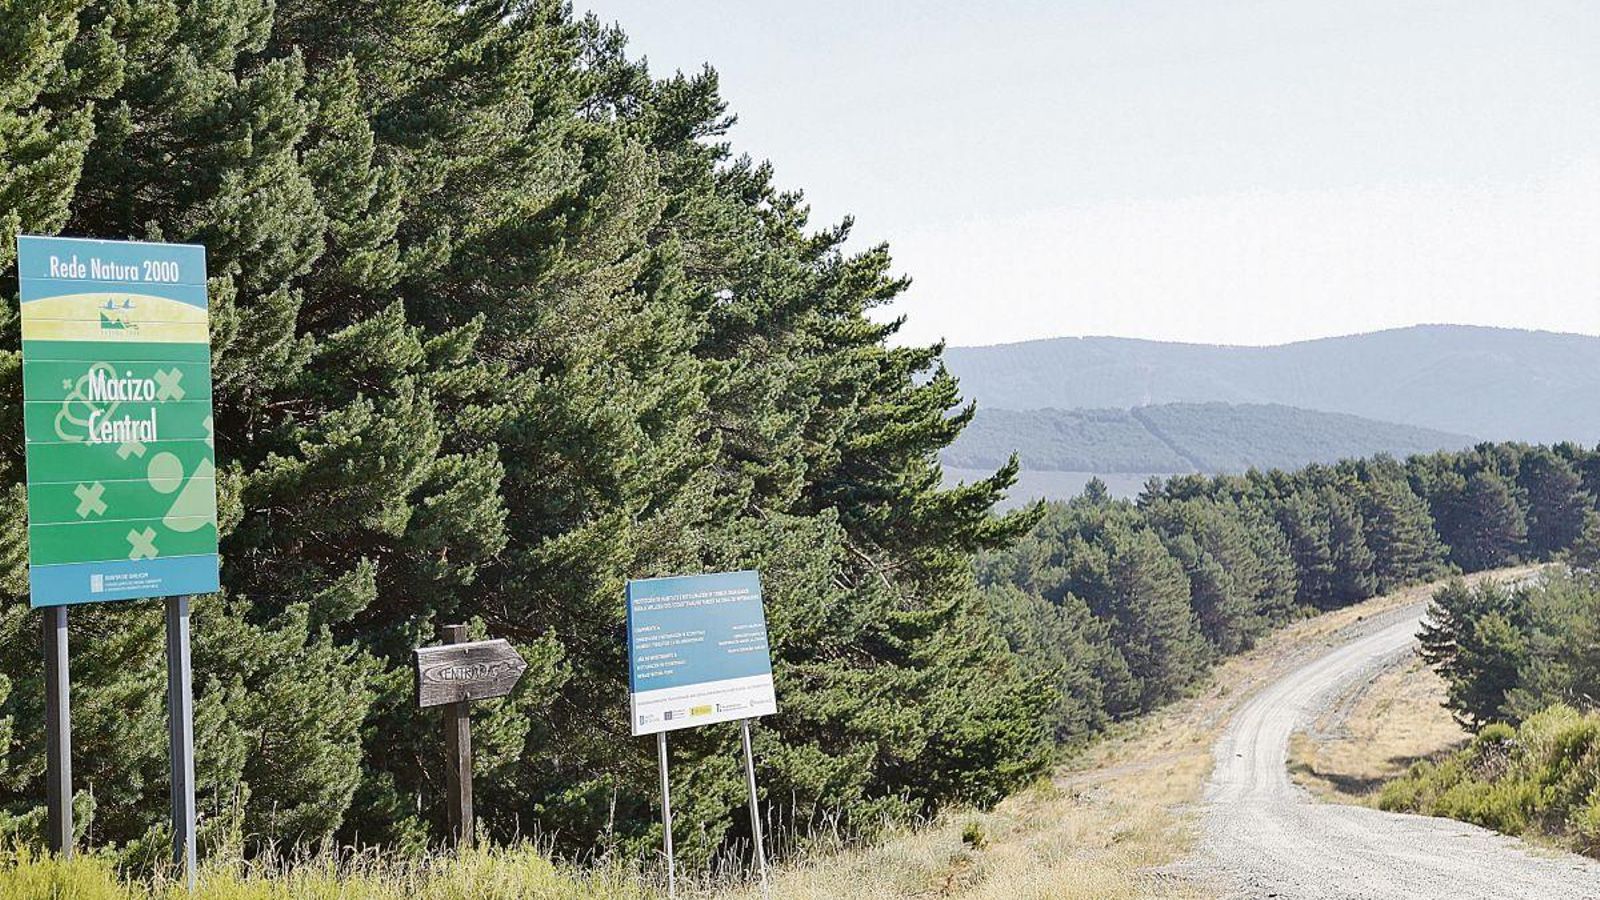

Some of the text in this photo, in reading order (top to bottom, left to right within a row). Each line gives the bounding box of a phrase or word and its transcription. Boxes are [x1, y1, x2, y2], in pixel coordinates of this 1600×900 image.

[50, 254, 180, 283] Rede Natura 2000
[88, 368, 156, 401] Macizo
[88, 407, 157, 443] Central
